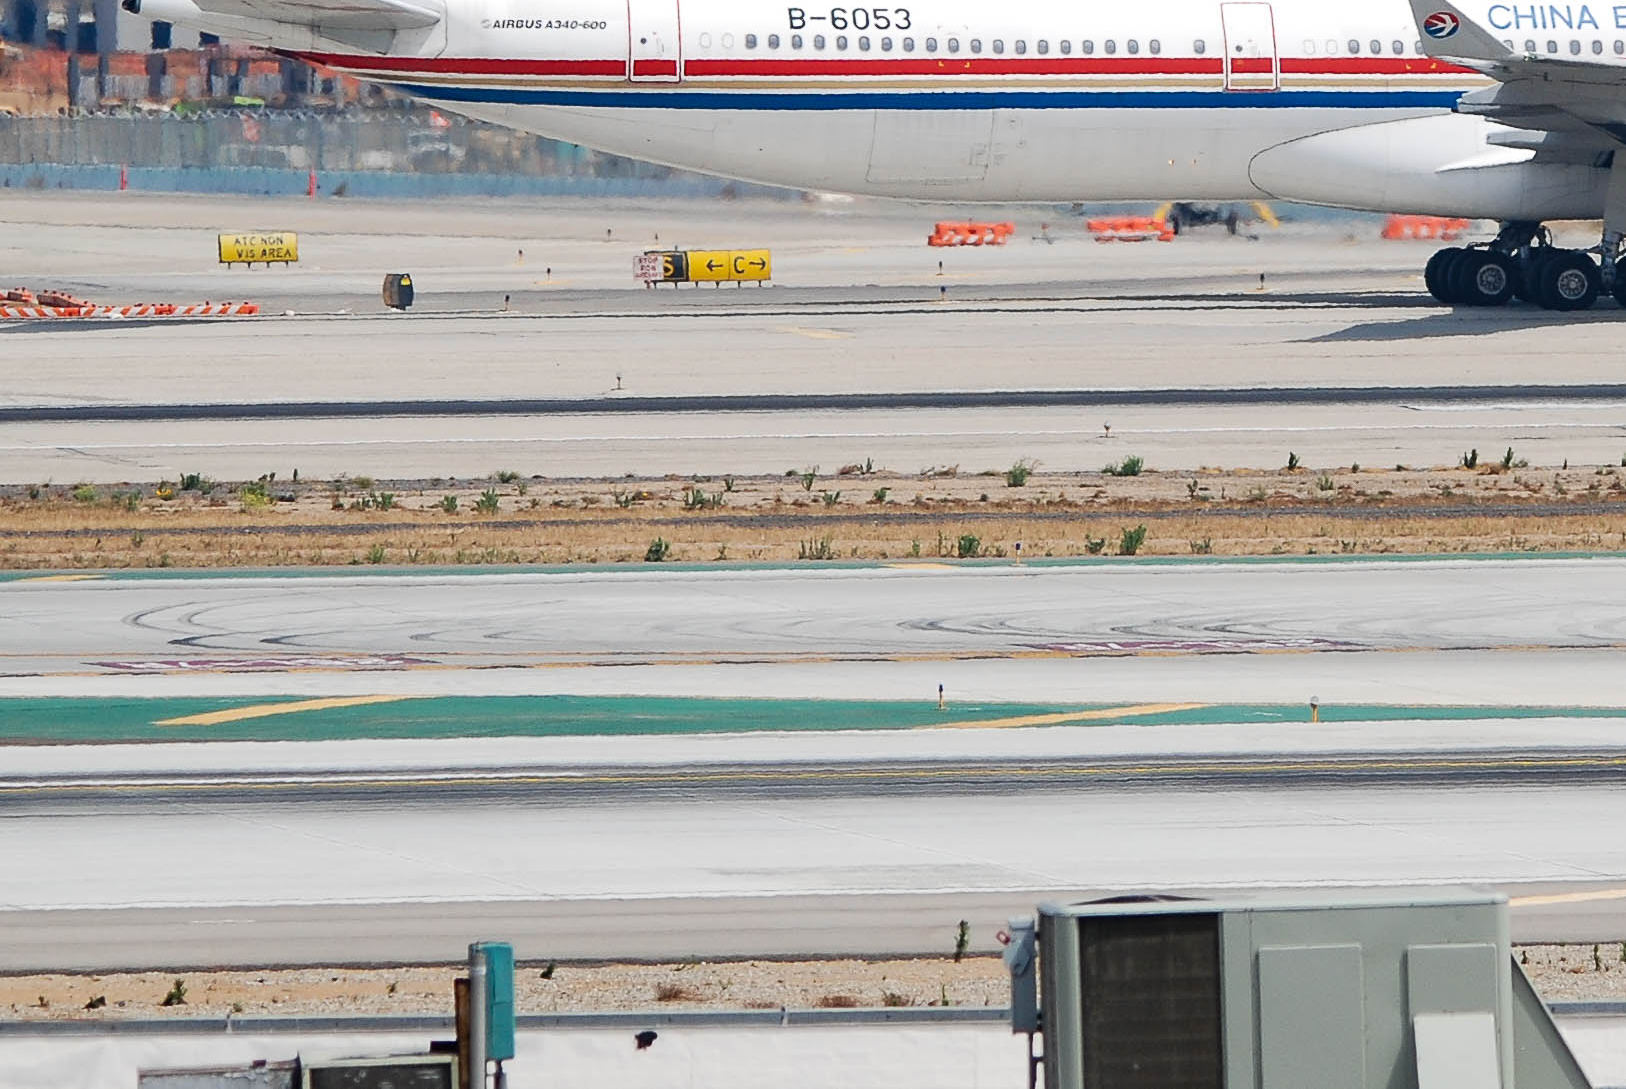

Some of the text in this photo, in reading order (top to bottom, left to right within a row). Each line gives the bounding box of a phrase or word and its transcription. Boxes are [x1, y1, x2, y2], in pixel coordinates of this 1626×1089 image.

[493, 19, 607, 30] AIRBUS A340-600
[788, 7, 912, 30] B-6053
[1488, 4, 1599, 30] CHINA
[234, 235, 284, 246] ATC NON
[236, 247, 292, 259] VIS AREA
[734, 256, 746, 274] C
